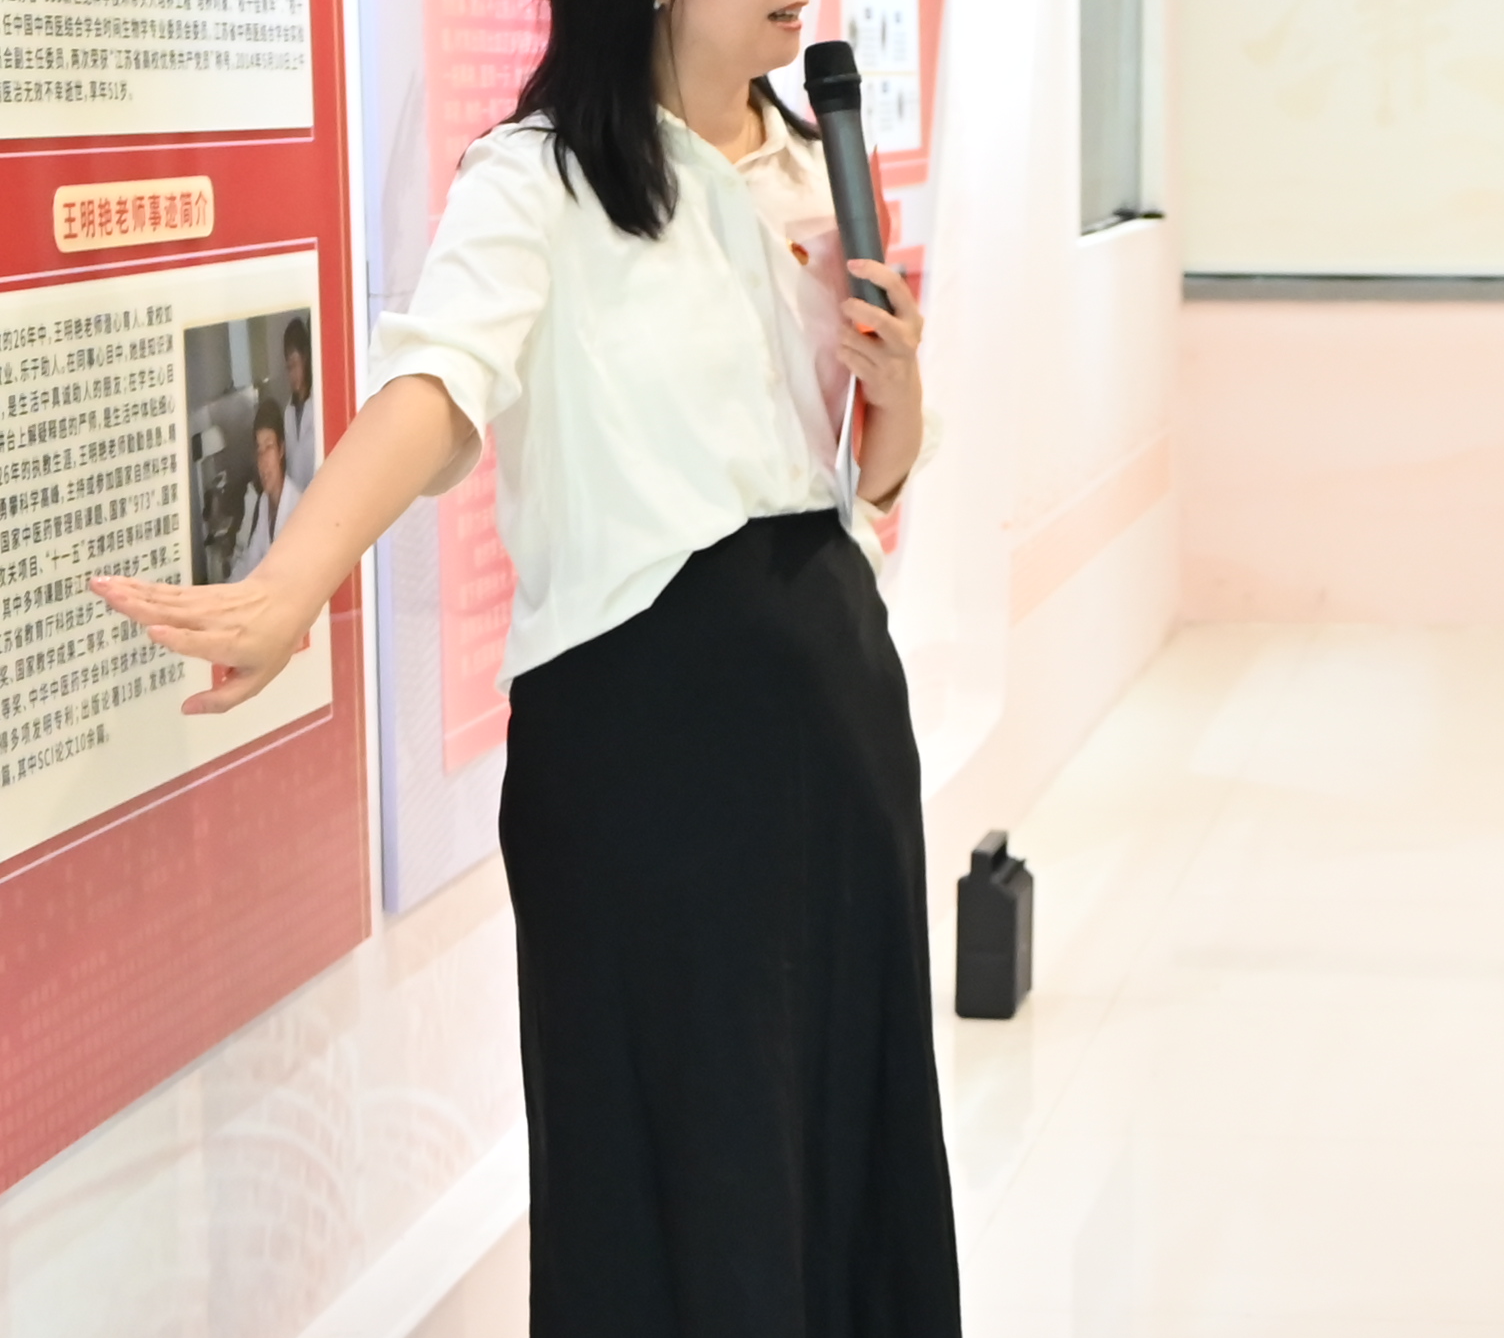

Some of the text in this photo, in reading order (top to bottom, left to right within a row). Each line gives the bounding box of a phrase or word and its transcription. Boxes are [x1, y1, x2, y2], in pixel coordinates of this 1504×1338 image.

[62, 190, 209, 240] 王明艳老师事迹简介
